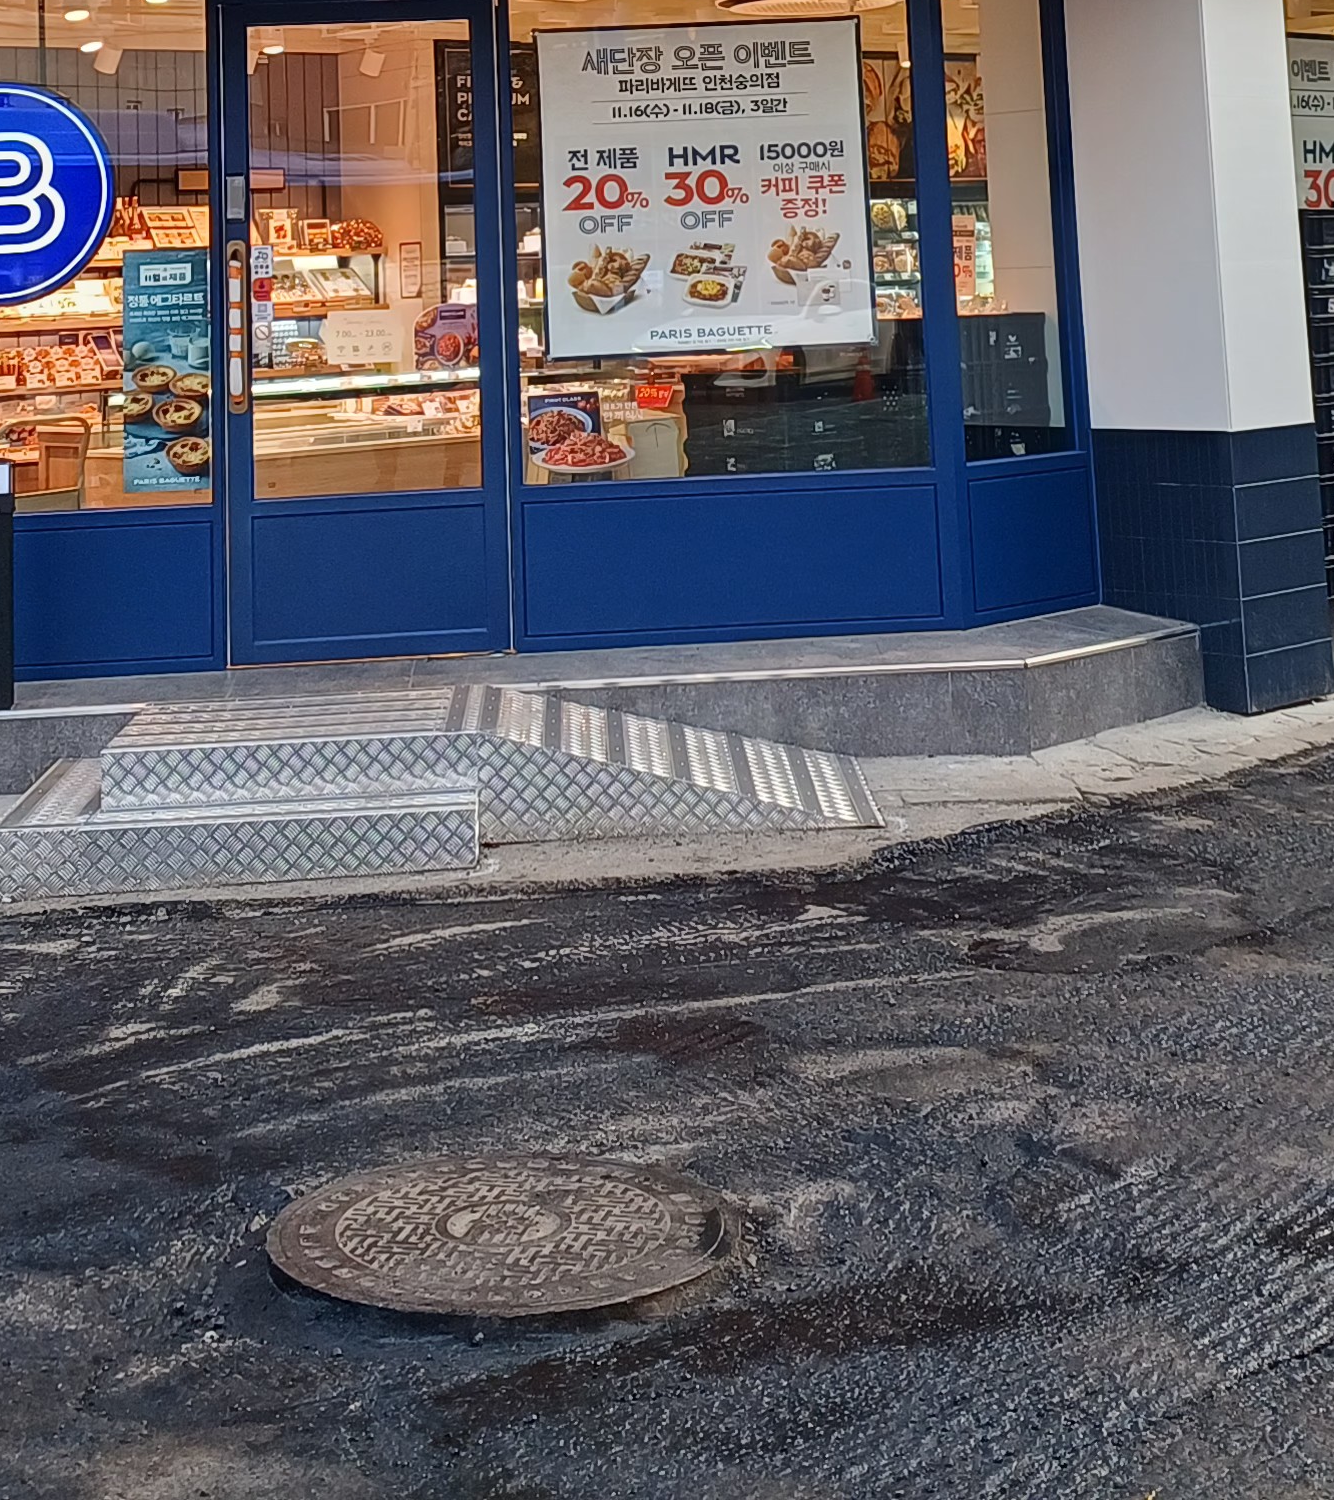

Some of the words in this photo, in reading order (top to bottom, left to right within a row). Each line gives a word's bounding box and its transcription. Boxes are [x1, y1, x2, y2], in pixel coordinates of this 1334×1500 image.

[581, 46, 664, 76] 새단장
[671, 43, 726, 72] 오픈
[733, 40, 815, 69] 이벤트
[1291, 58, 1331, 83] 이벤트
[618, 75, 698, 95] 파리바게뜨
[702, 72, 781, 92] 인천숭의점
[611, 102, 670, 120] 11.16(수)
[750, 97, 788, 114] 3일간
[568, 148, 589, 171] 전
[596, 146, 640, 170] 제품
[667, 144, 741, 168] HMR
[759, 140, 845, 161] 15000원
[772, 161, 795, 174] 이상
[798, 160, 831, 173] 구매시
[562, 173, 650, 212] 20%
[663, 168, 750, 208] 30%
[760, 173, 799, 197] 커피
[807, 173, 847, 195] 쿠폰
[680, 209, 734, 231] OFF
[780, 198, 828, 219] 증정!
[579, 213, 633, 235] OFF
[650, 328, 693, 340] PARIS
[696, 325, 773, 338] BAGUETTE
